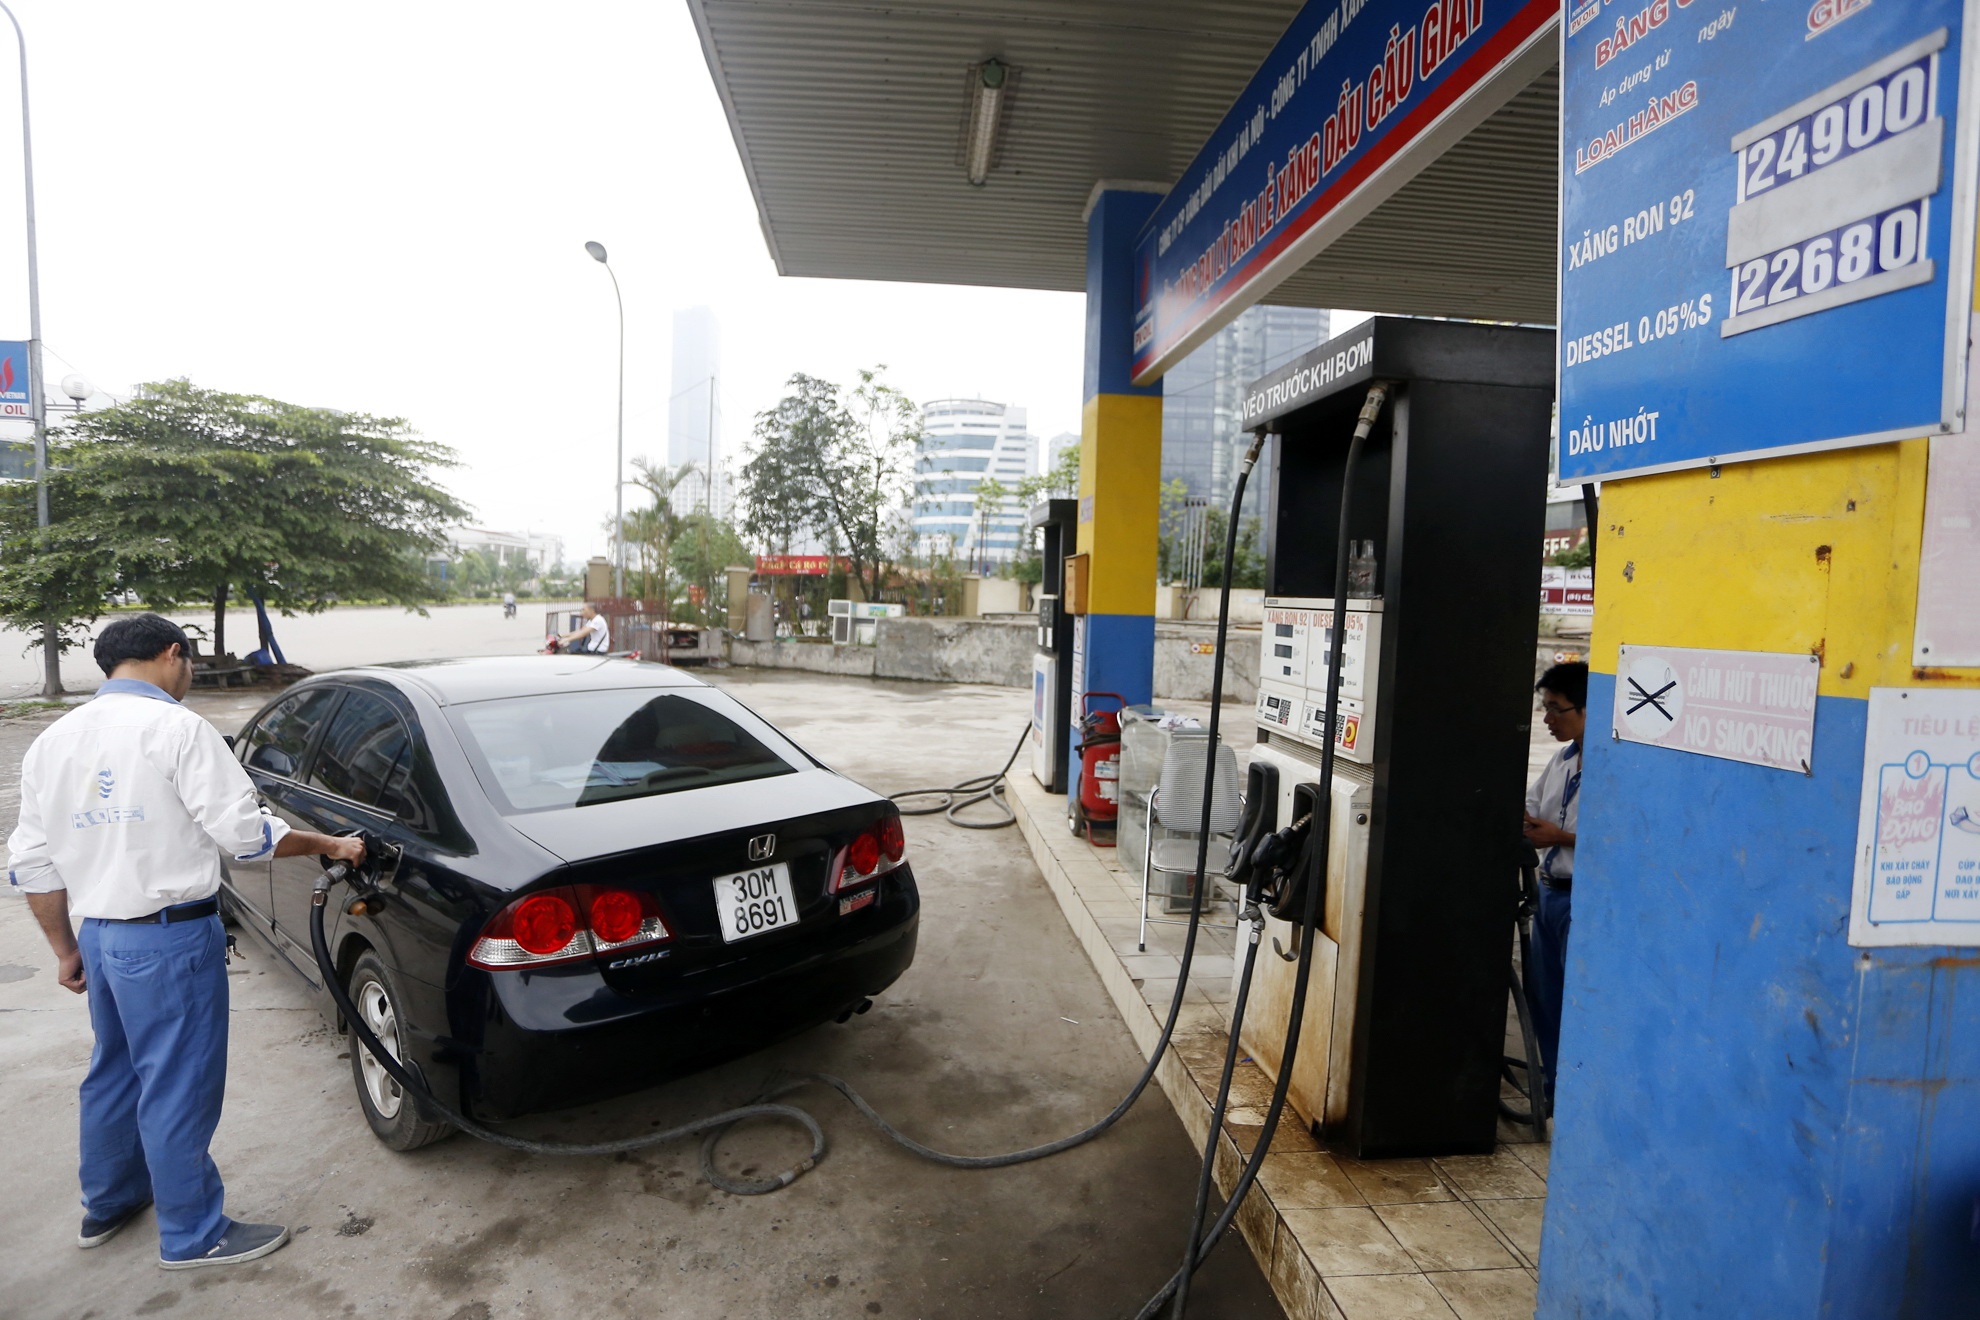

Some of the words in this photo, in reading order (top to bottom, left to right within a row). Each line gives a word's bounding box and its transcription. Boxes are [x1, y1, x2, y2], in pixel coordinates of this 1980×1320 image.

[1571, 17, 1581, 31] PV
[1583, 6, 1596, 21] OIL
[1594, 0, 1669, 71] BẢNG
[1250, 104, 1264, 146] NỘI
[1271, 65, 1295, 120] CÔNG
[1297, 47, 1309, 87] TY
[1311, 7, 1338, 70] TNHH
[1598, 86, 1616, 108] Áp
[1619, 64, 1652, 93] dụng
[1655, 49, 1672, 71] từ
[1697, 7, 1737, 43] ngày
[1216, 218, 1230, 280] LÝ
[1230, 199, 1257, 268] BÁN
[1257, 161, 1275, 242] LẺ
[1275, 131, 1321, 225] XĂNG
[1322, 77, 1364, 178] DẦU
[1366, 22, 1416, 132] CẦU
[1576, 122, 1624, 170] LOẠI
[1628, 80, 1697, 141] HÀNG
[1745, 66, 1926, 197] 24900
[1568, 224, 1619, 272] XĂNG
[1623, 201, 1665, 247] RON
[1669, 188, 1695, 226] 92
[1736, 208, 1919, 313] 22680
[1566, 321, 1633, 368] DIESSEL
[1638, 293, 1713, 345] 0.05%S
[1266, 367, 1310, 410] TRƯỚC
[1310, 356, 1335, 391] KHI
[1335, 336, 1375, 379] BƠM
[5, 404, 27, 416] OIL
[1569, 414, 1605, 457] DẦU
[1609, 405, 1660, 449] NHỚT
[1285, 611, 1298, 626] RON
[1299, 612, 1308, 627] 92
[1312, 612, 1334, 629] DIESE
[1687, 657, 1722, 701] CẤM
[1724, 664, 1757, 704] HÚT
[1758, 664, 1815, 711] THUỐC
[1683, 714, 1711, 748] NO
[1713, 718, 1811, 764] SMOKING
[1902, 713, 1949, 736] TIÊU
[1880, 816, 1936, 847] ĐỘNG
[732, 867, 777, 904] 30M
[734, 895, 787, 934] 8691
